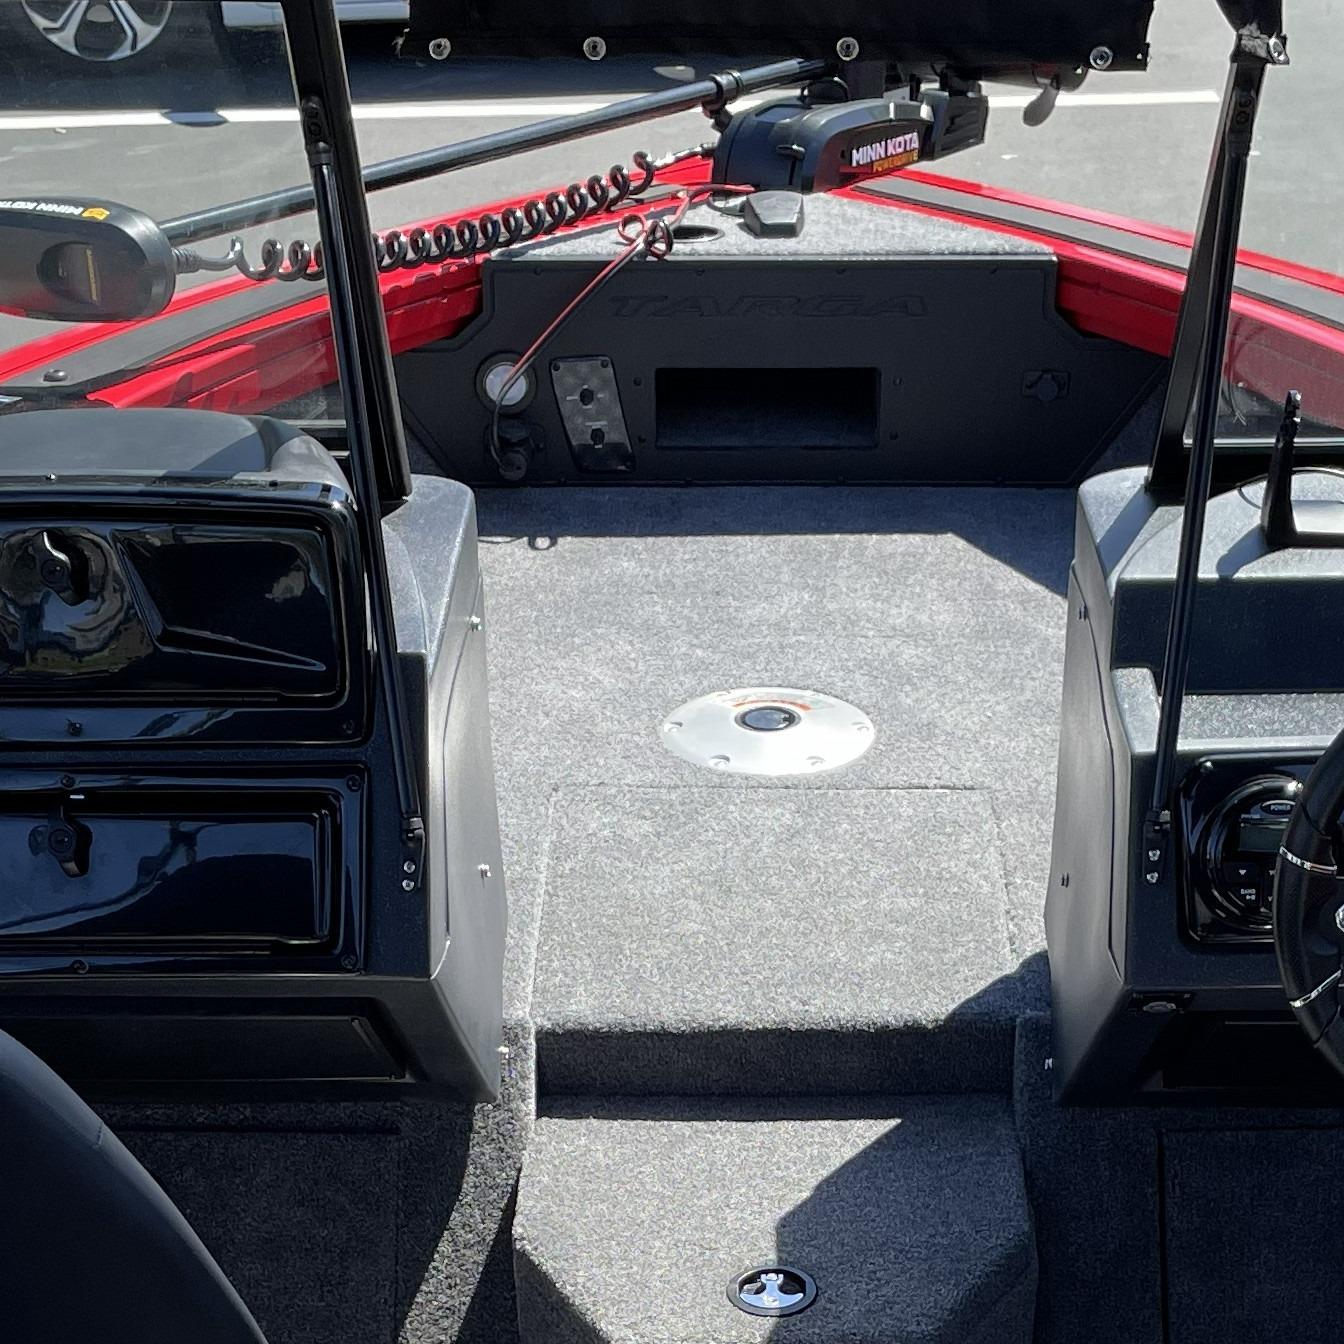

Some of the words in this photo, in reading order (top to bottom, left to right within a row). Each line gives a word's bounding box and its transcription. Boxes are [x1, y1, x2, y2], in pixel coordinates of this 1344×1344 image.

[851, 142, 886, 167] MINN
[886, 132, 920, 157] KOTA
[35, 202, 84, 215] MINN
[609, 294, 930, 319] TARGA
